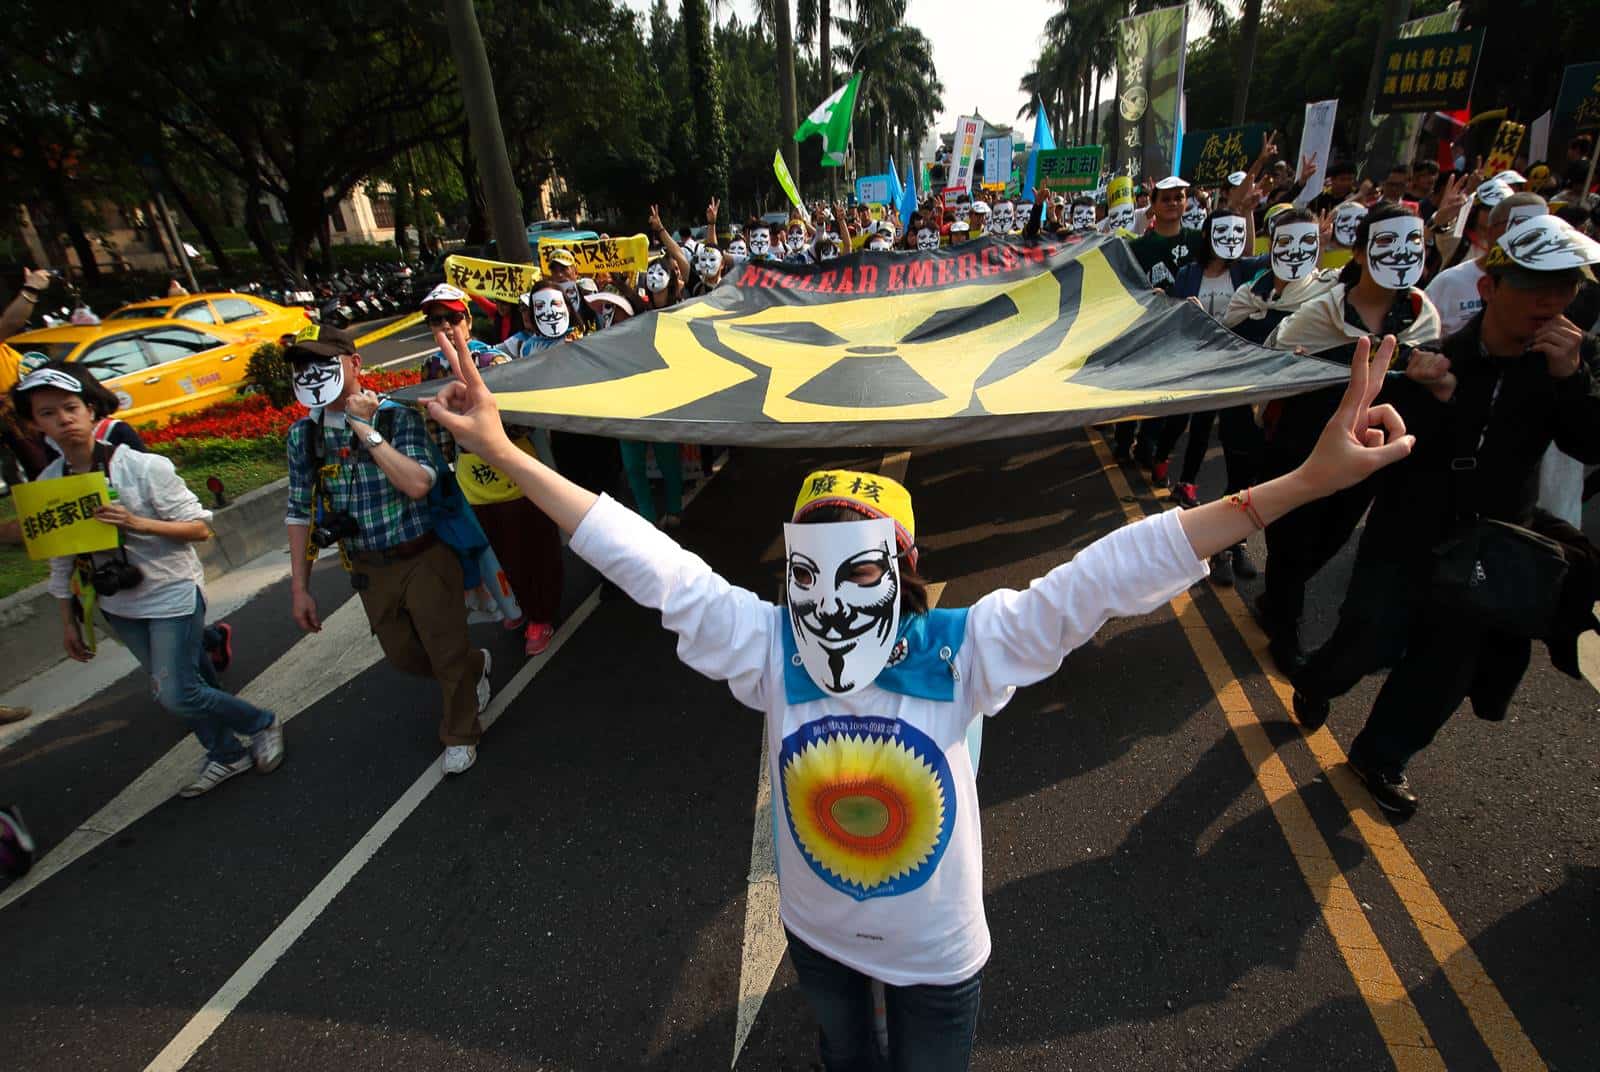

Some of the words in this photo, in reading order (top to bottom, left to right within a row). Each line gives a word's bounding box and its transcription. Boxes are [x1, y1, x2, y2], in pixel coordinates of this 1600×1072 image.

[736, 263, 879, 295] NUCLEAR
[808, 473, 884, 503] 廢核
[23, 492, 102, 540] 非核家園
